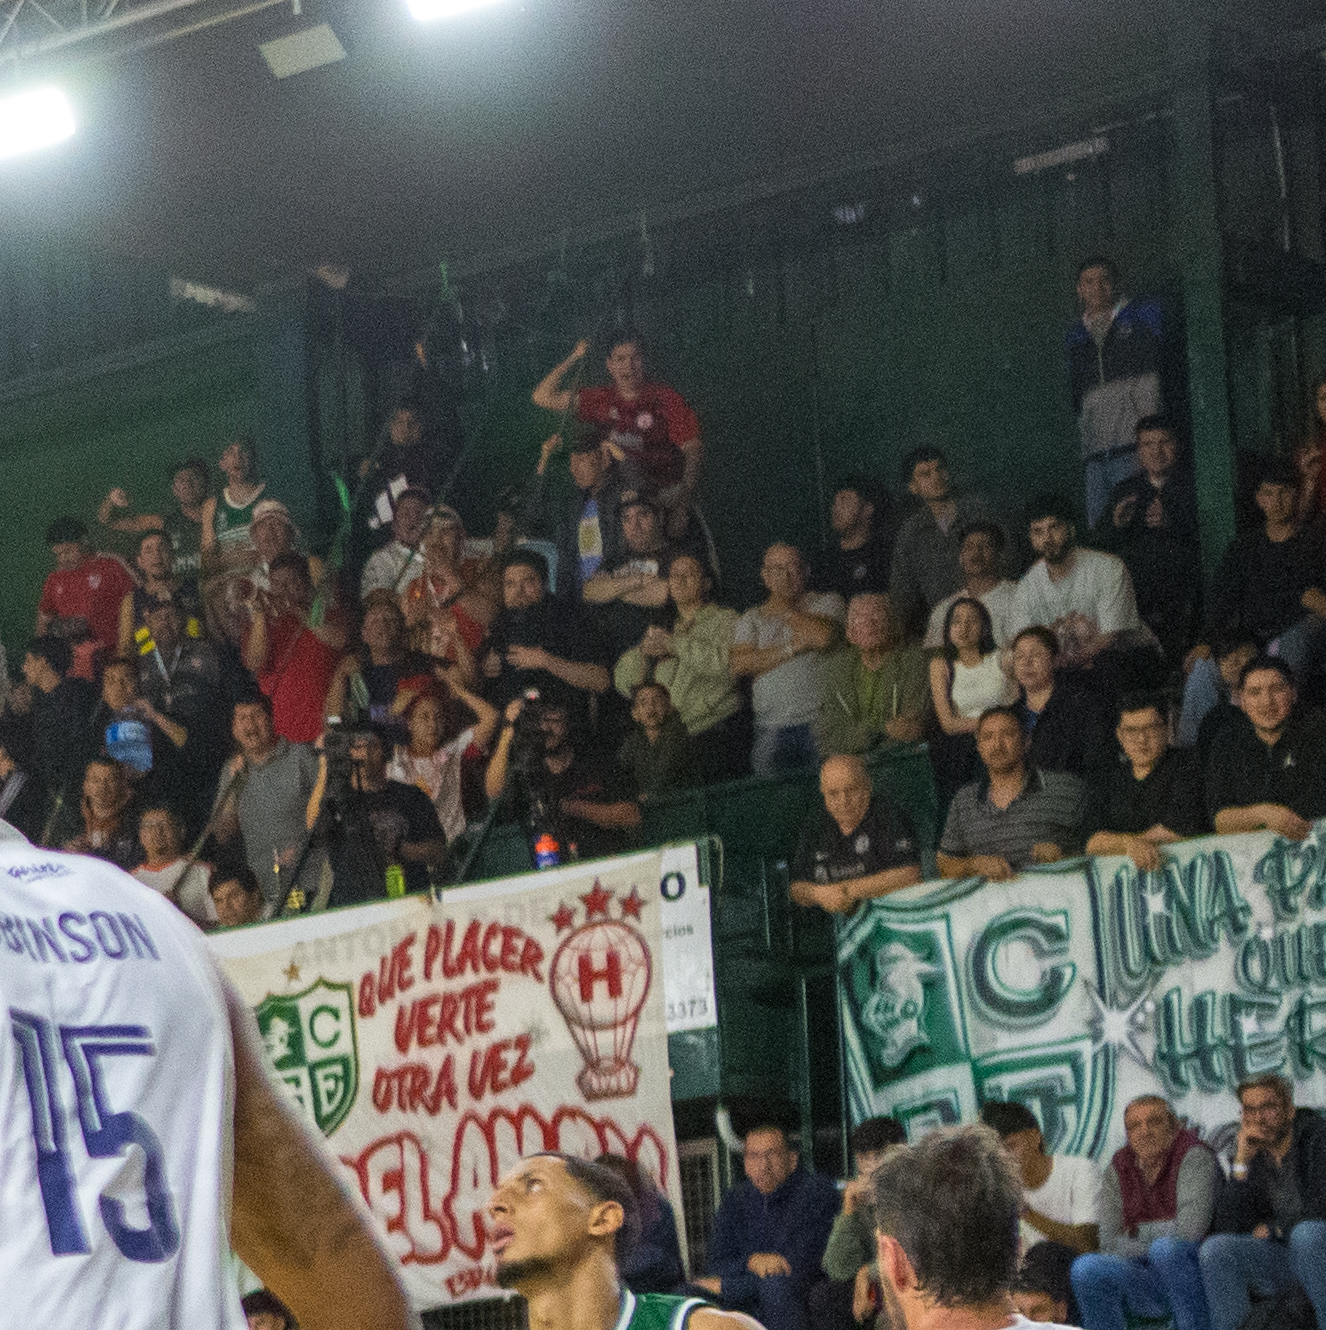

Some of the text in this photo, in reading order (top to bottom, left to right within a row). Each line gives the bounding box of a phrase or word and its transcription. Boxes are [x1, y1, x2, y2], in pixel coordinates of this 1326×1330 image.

[423, 917, 545, 984] PLACER
[577, 950, 623, 1003] H
[395, 978, 501, 1054] VERTE
[373, 1034, 536, 1116] OTRA VEZ
[10, 1007, 181, 1264] 15
